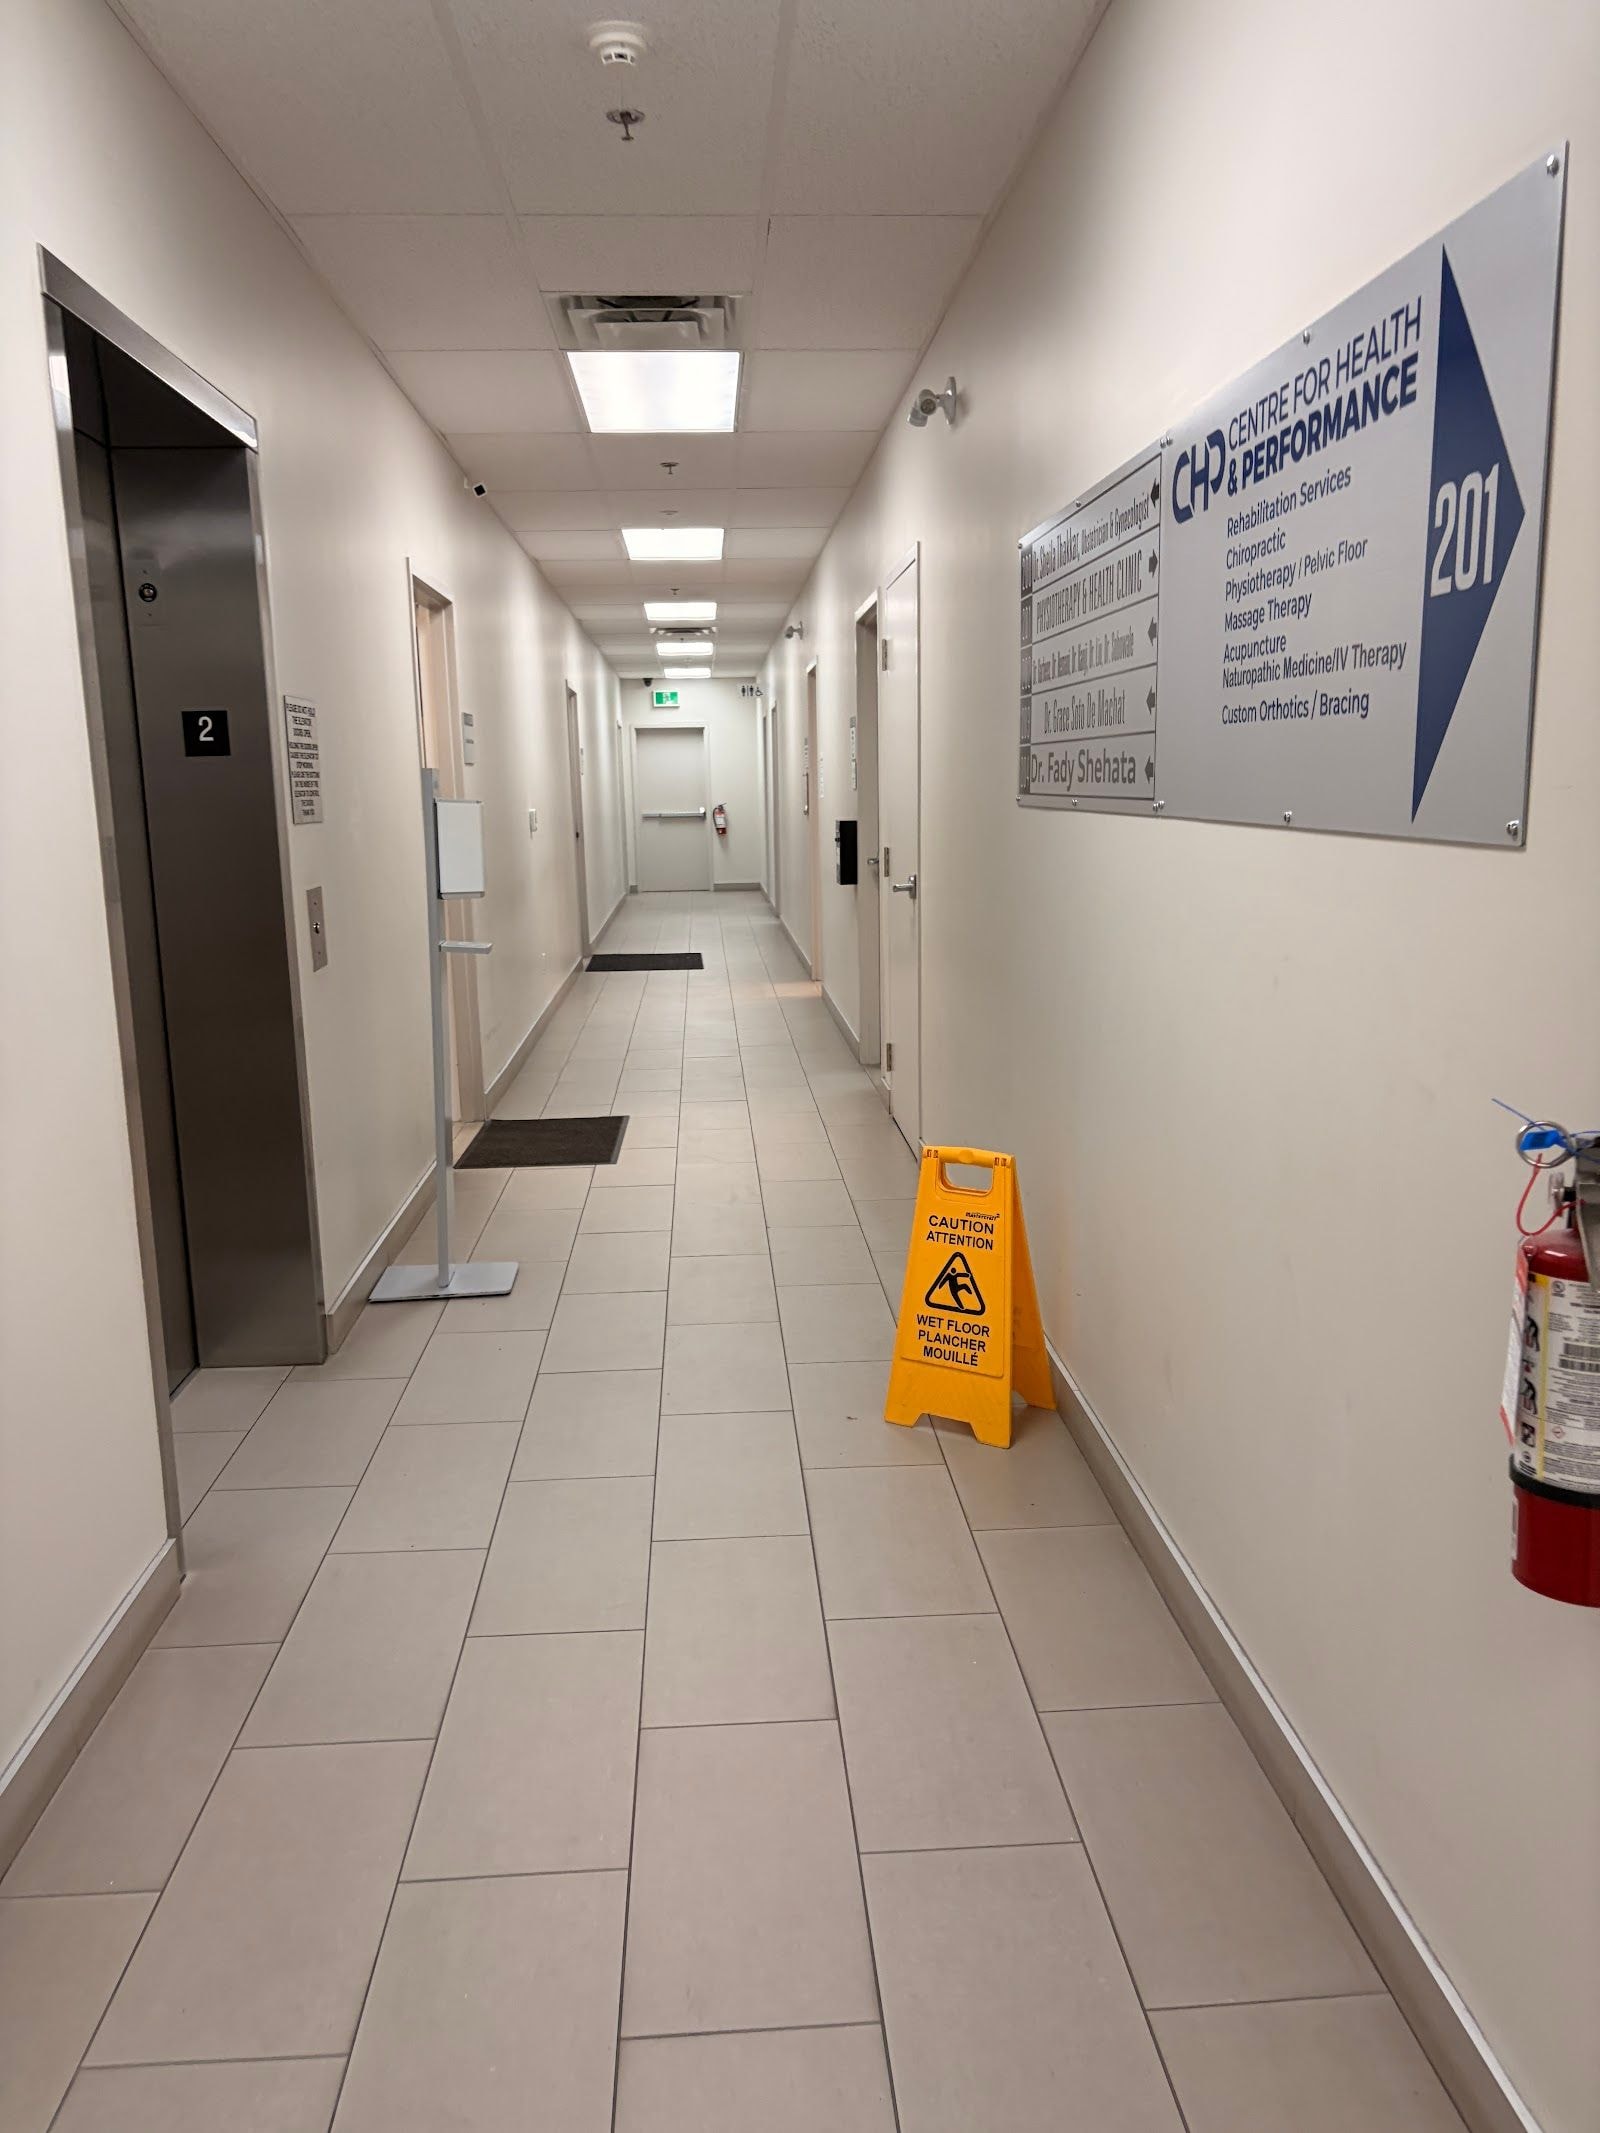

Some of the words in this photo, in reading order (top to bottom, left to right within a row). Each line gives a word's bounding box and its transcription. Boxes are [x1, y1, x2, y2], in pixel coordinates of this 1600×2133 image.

[1229, 382, 1289, 451] CENTRE
[1294, 357, 1330, 414] FOR
[1335, 295, 1422, 388] HEALTH
[1228, 458, 1238, 497] &
[1242, 351, 1418, 490] PERFORMANCE
[1115, 492, 1150, 540] Gynecologist
[1227, 491, 1297, 538] Rehabilitation
[1300, 466, 1351, 506] Services
[1226, 527, 1286, 570] Chiropractic
[1430, 462, 1499, 598] 201
[1037, 580, 1081, 634] PHYSIOTHERAPY
[1089, 564, 1114, 612] HEALTH
[1116, 549, 1142, 601] CLINIC
[1226, 561, 1297, 603] Physiotherapy
[1304, 547, 1335, 577] Pelvic
[1338, 538, 1368, 566] Floor
[1225, 606, 1265, 632] Massage
[1267, 593, 1312, 621] Therapy
[1223, 634, 1287, 665] Acupuncture
[1223, 659, 1281, 689] Naturopathic
[1283, 645, 1349, 680] Medicine/IV
[1352, 641, 1407, 671] Therapy
[1044, 701, 1052, 734] Dr.
[1053, 699, 1070, 733] Grace
[1071, 695, 1085, 731] Soto
[1087, 692, 1096, 728] De
[1097, 687, 1126, 727] Machat
[1222, 704, 1257, 725] Custom
[1259, 695, 1309, 721] Orthotics
[1311, 689, 1318, 720] /
[1319, 688, 1370, 719] Bracing
[198, 715, 215, 742] 2
[1031, 753, 1044, 783] Dr.
[1048, 750, 1075, 792] Fady
[1077, 748, 1136, 784] Shehata
[926, 1230, 994, 1250] ATTENTION
[929, 1215, 994, 1235] CAUTION
[917, 1314, 944, 1328] WET
[947, 1319, 990, 1338] FLOOR
[918, 1329, 986, 1352] PLANCHER
[923, 1345, 978, 1366] MOUILLÉ
